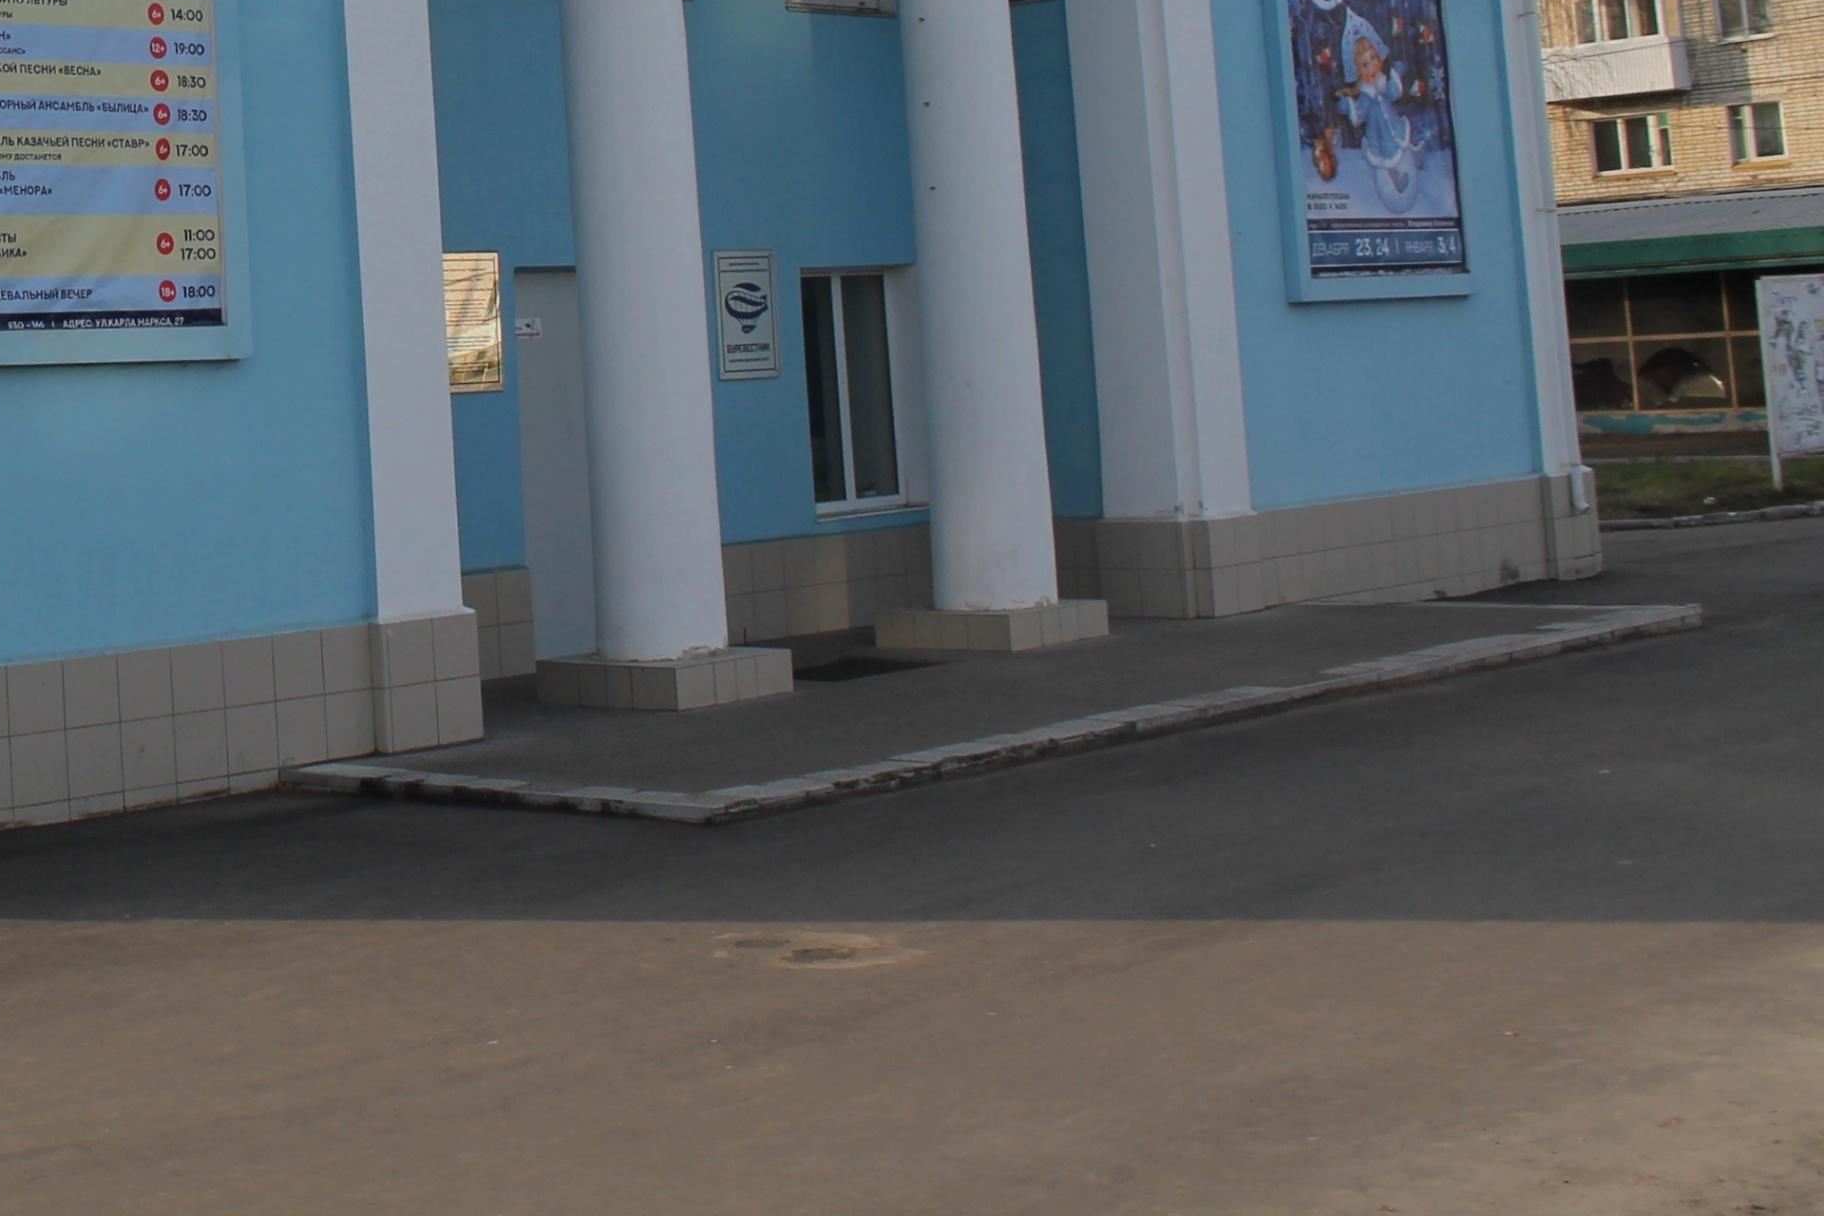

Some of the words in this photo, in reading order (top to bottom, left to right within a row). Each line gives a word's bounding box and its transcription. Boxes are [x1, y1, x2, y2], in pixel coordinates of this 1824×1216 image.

[170, 8, 203, 21] 14:00
[151, 43, 165, 53] 12+
[174, 42, 205, 55] 19:00
[20, 63, 56, 75] ПЕСНИ
[58, 65, 101, 76] «ВЕСНА»
[155, 76, 165, 86] 6+
[177, 75, 206, 88] 18:30
[38, 100, 95, 112] АНСАМБЛЬ
[96, 102, 149, 114] «БЫЛИЦА»
[157, 110, 167, 119] 6+
[177, 109, 207, 122] 18:30
[17, 135, 69, 147] КАЗАЧЬЕЙ
[71, 137, 105, 147] ПЕСНИ
[107, 138, 150, 148] «СТАВР»
[176, 144, 208, 157] 17:00
[158, 185, 167, 194] 6+
[178, 184, 211, 197] 17:00
[184, 229, 215, 241] 11:00
[160, 239, 170, 248] 6+
[181, 248, 216, 260] 17:00
[61, 289, 92, 299] ВЕЧЕР
[161, 287, 174, 297] 18+
[183, 285, 215, 298] 18:00
